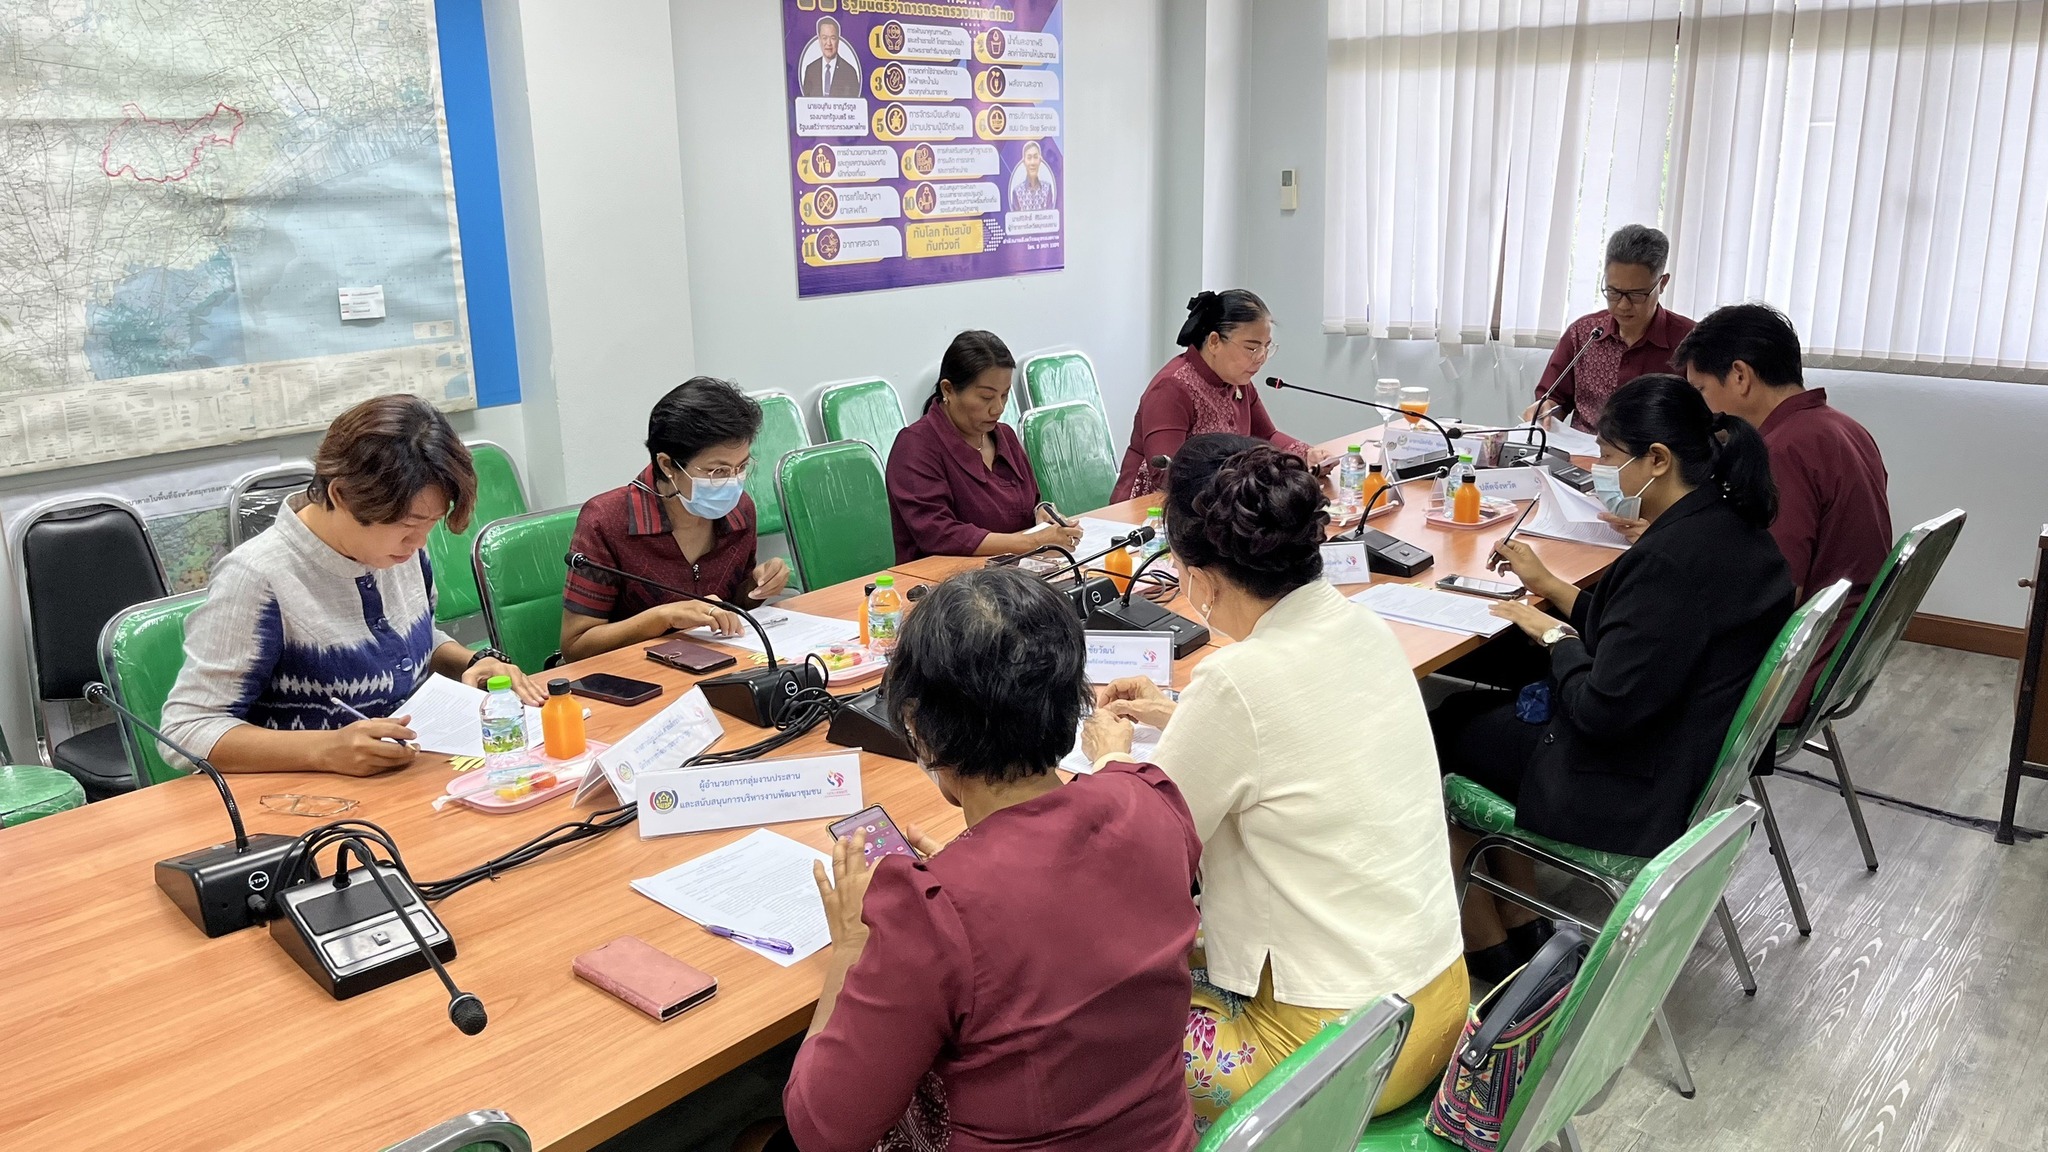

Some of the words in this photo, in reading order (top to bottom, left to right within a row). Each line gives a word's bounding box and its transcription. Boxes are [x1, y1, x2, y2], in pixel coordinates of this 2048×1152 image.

[875, 33, 881, 49] 1
[875, 76, 882, 91] 3
[978, 80, 984, 94] 4
[877, 118, 884, 133] 5
[979, 118, 986, 132] 6
[801, 159, 809, 175] 7
[904, 156, 912, 171] 8
[803, 203, 812, 218] 9
[904, 196, 915, 211] 10
[913, 225, 940, 239] ทันโลก
[943, 223, 972, 237] ทันสมัย
[804, 242, 816, 257] 11
[926, 237, 960, 252] ทันท่วงที
[699, 771, 801, 792] ผู้อำนวยการกลุ่มงานประสาน
[679, 788, 823, 810] และสนับสนุนการบริหารงานพัฒนาชุมชน
